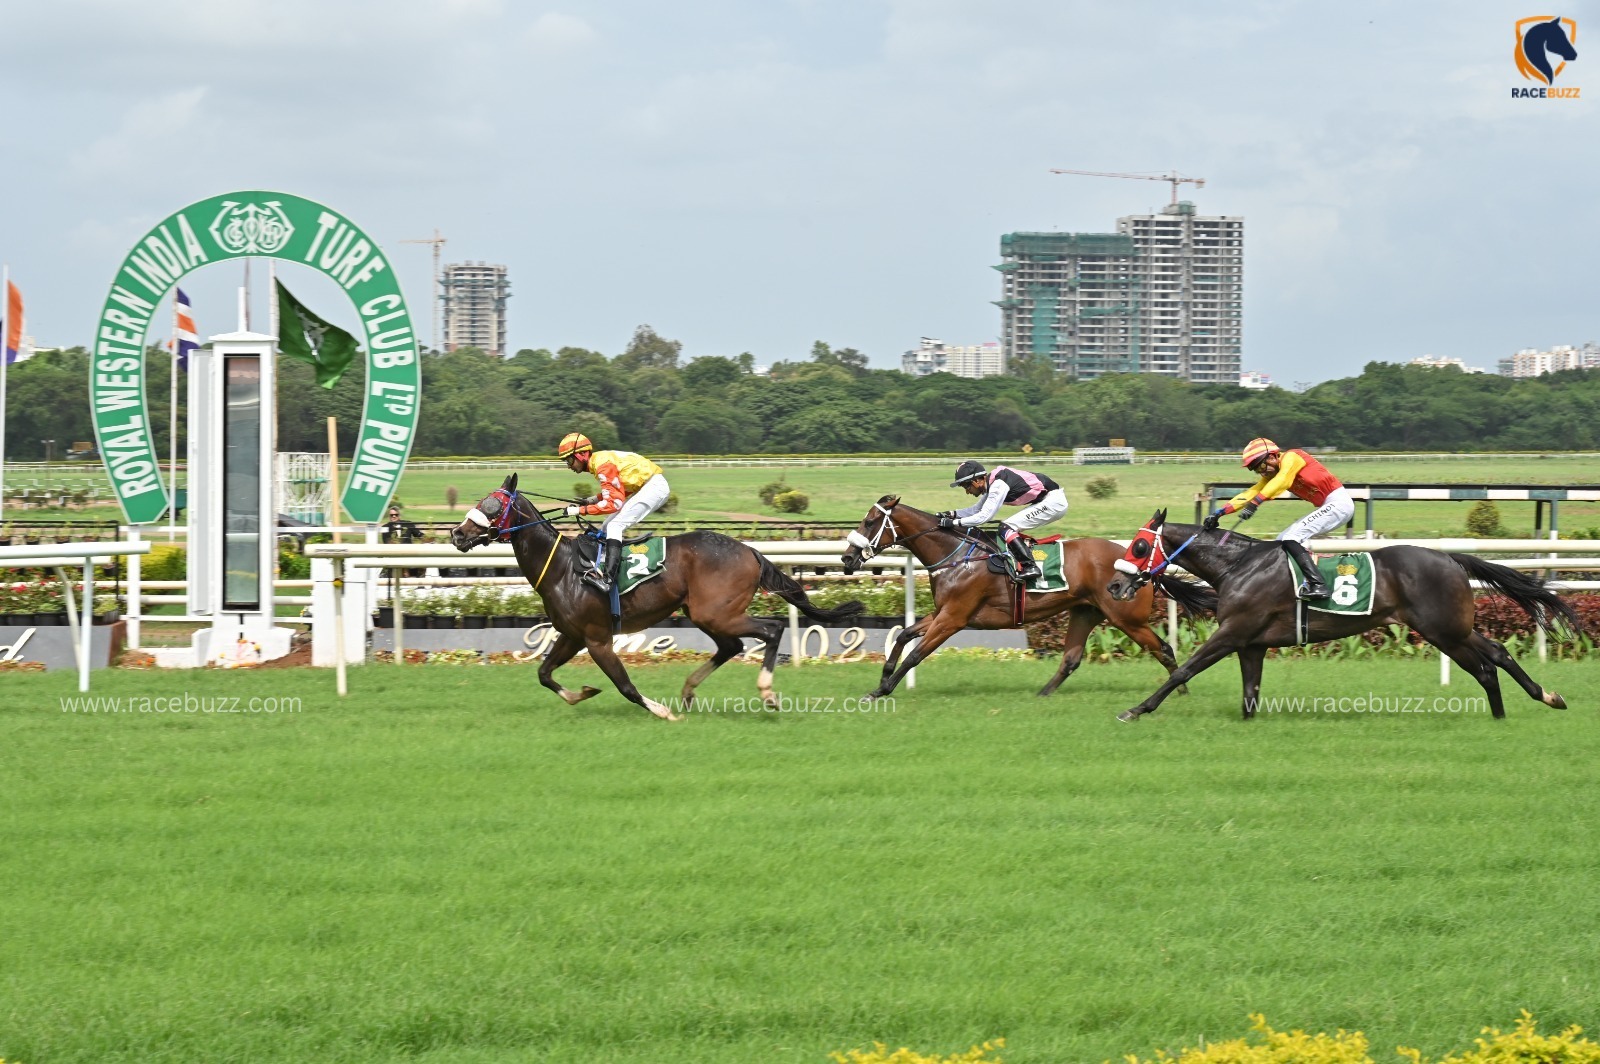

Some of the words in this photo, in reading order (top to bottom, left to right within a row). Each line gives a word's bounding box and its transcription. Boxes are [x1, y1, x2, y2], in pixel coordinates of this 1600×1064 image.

[122, 213, 209, 297] INDIA
[304, 211, 386, 290] TURF
[96, 285, 156, 413] WESTERN
[360, 294, 415, 369] CLUB
[371, 380, 416, 416] LTD
[100, 414, 160, 499] ROYAL
[350, 419, 411, 497] PUNE
[626, 553, 651, 580] 2
[1332, 574, 1359, 606] 6
